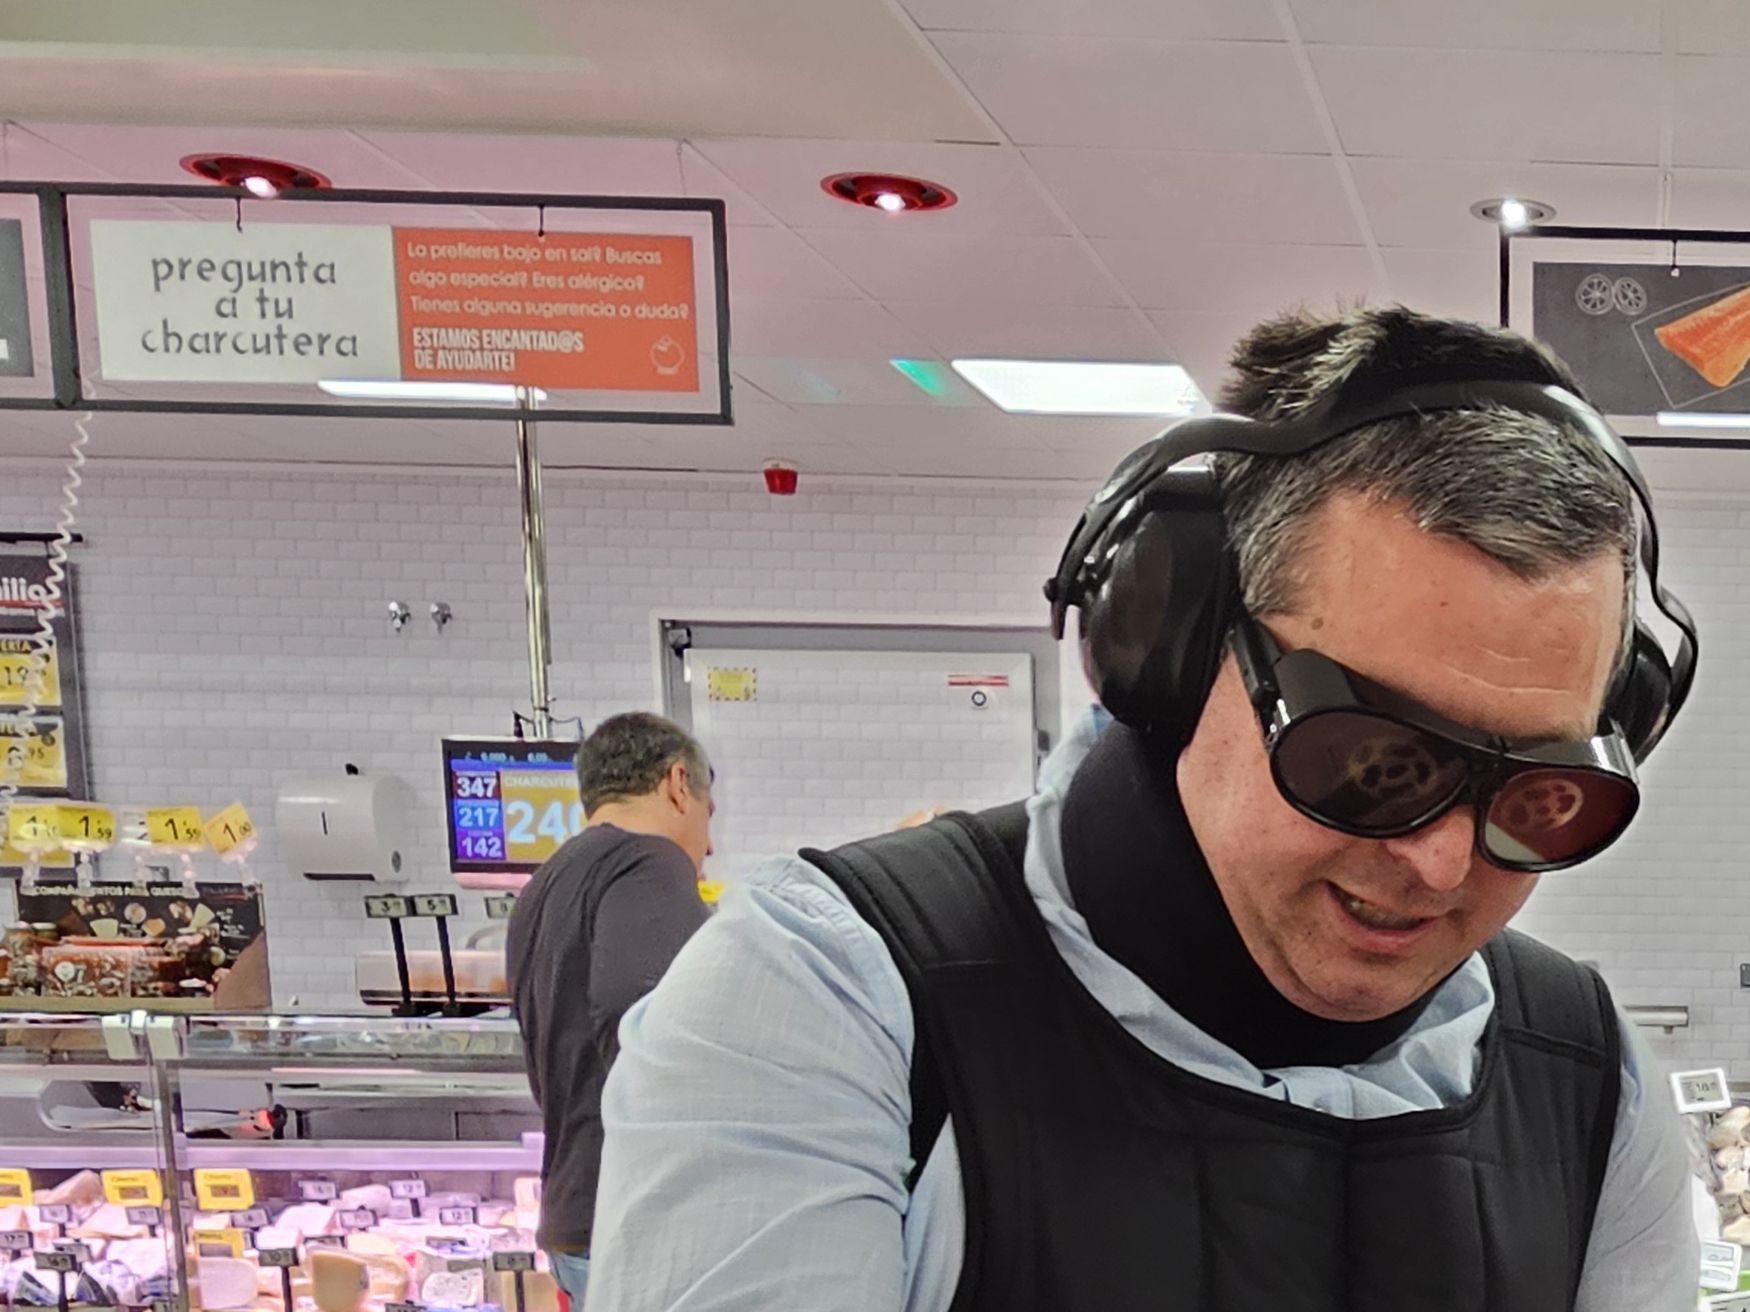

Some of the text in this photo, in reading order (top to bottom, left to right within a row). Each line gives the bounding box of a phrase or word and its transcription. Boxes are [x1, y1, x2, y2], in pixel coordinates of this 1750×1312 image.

[407, 242, 426, 258] Lo
[503, 244, 541, 265] bajo
[545, 248, 567, 263] en
[605, 247, 662, 265] Buscas
[151, 251, 337, 294] pregunta
[409, 271, 447, 290] algo
[532, 273, 564, 289] Eres
[215, 287, 294, 320] a tu
[410, 296, 460, 314] Tienes
[464, 297, 522, 317] alguna
[525, 300, 616, 320] sugerencia
[634, 303, 689, 320] duda?
[141, 316, 359, 358] charcutera
[413, 327, 584, 353] ESTAMOS ENCANTAD@S
[415, 349, 433, 370] DE
[457, 777, 498, 799] 347
[458, 806, 499, 828] 217
[461, 836, 503, 858] 142
